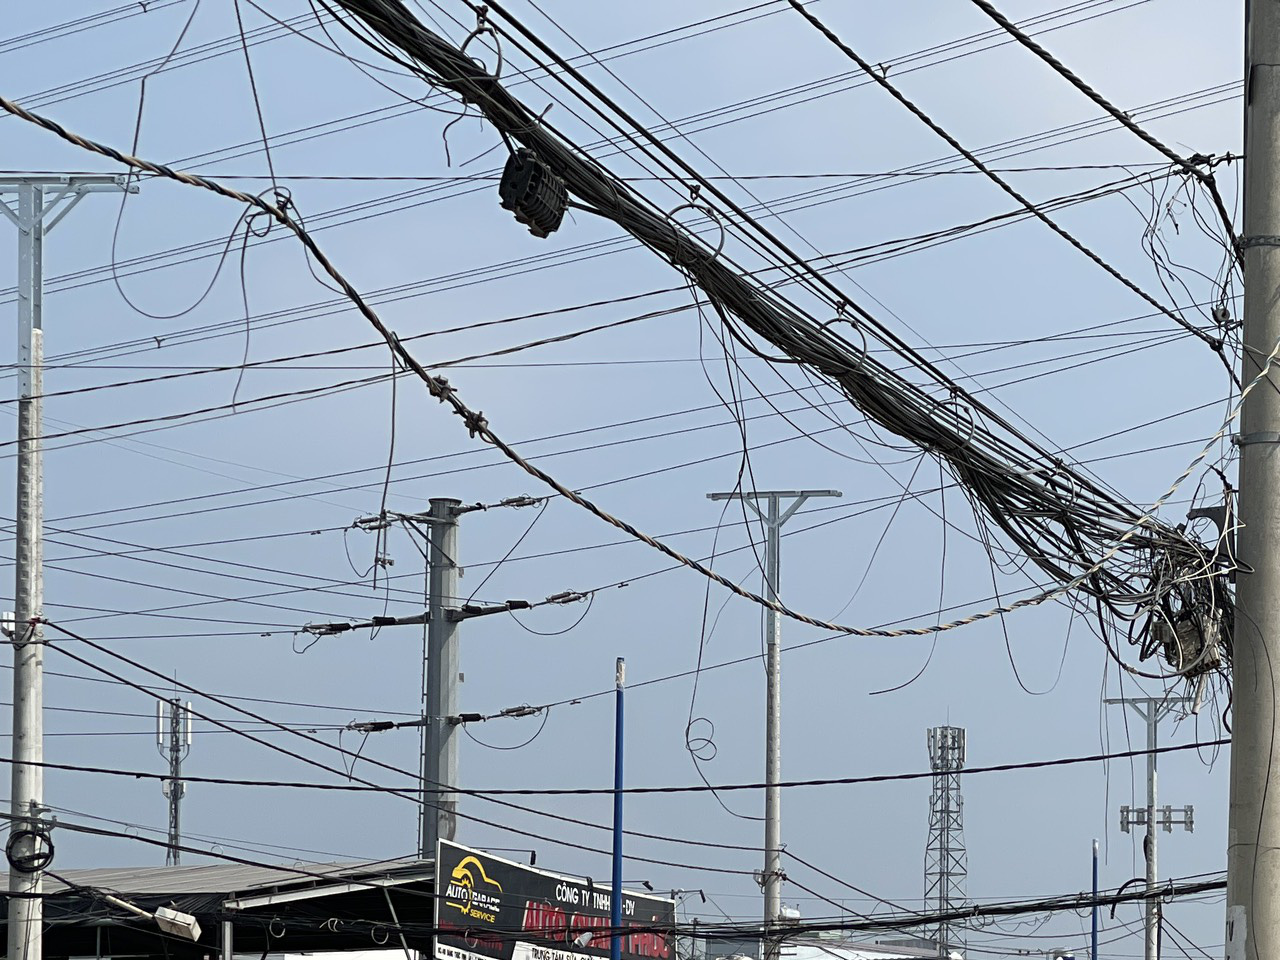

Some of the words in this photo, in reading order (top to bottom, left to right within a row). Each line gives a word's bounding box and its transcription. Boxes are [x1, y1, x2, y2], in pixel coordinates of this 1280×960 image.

[556, 882, 578, 904] CÔNG
[581, 889, 590, 906] TY
[592, 893, 611, 911] TNHH
